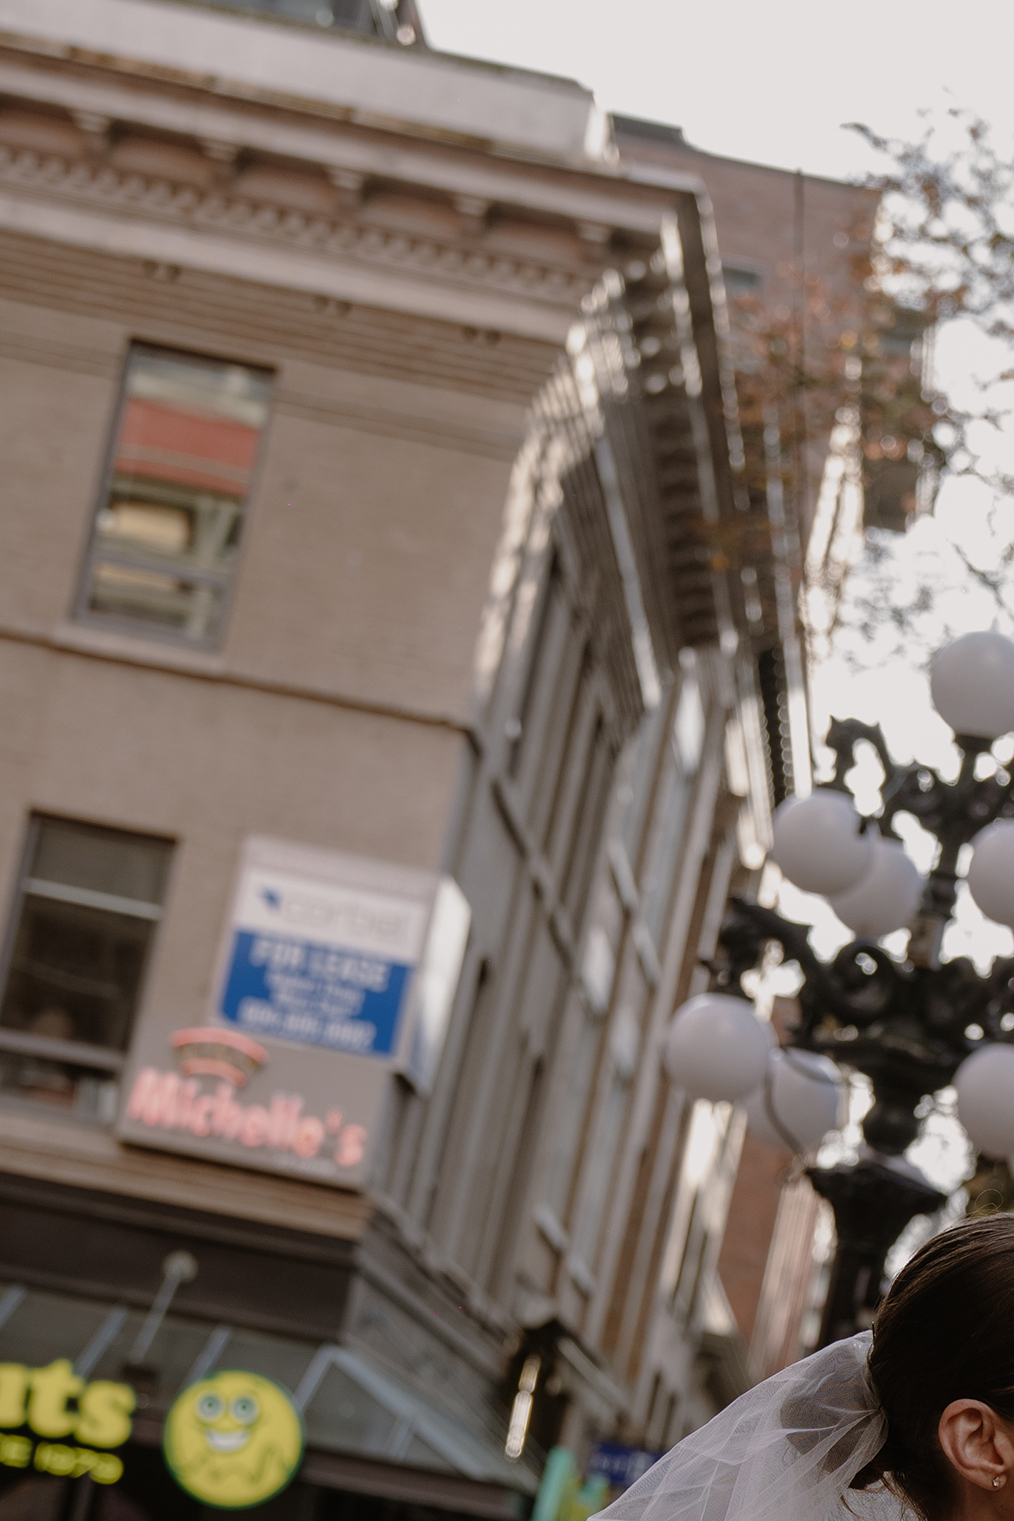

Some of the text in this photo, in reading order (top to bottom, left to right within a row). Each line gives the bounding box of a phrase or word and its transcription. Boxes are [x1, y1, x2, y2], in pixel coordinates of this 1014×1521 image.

[250, 937, 391, 992] FOR LEASE
[127, 1067, 367, 1167] Michelle's
